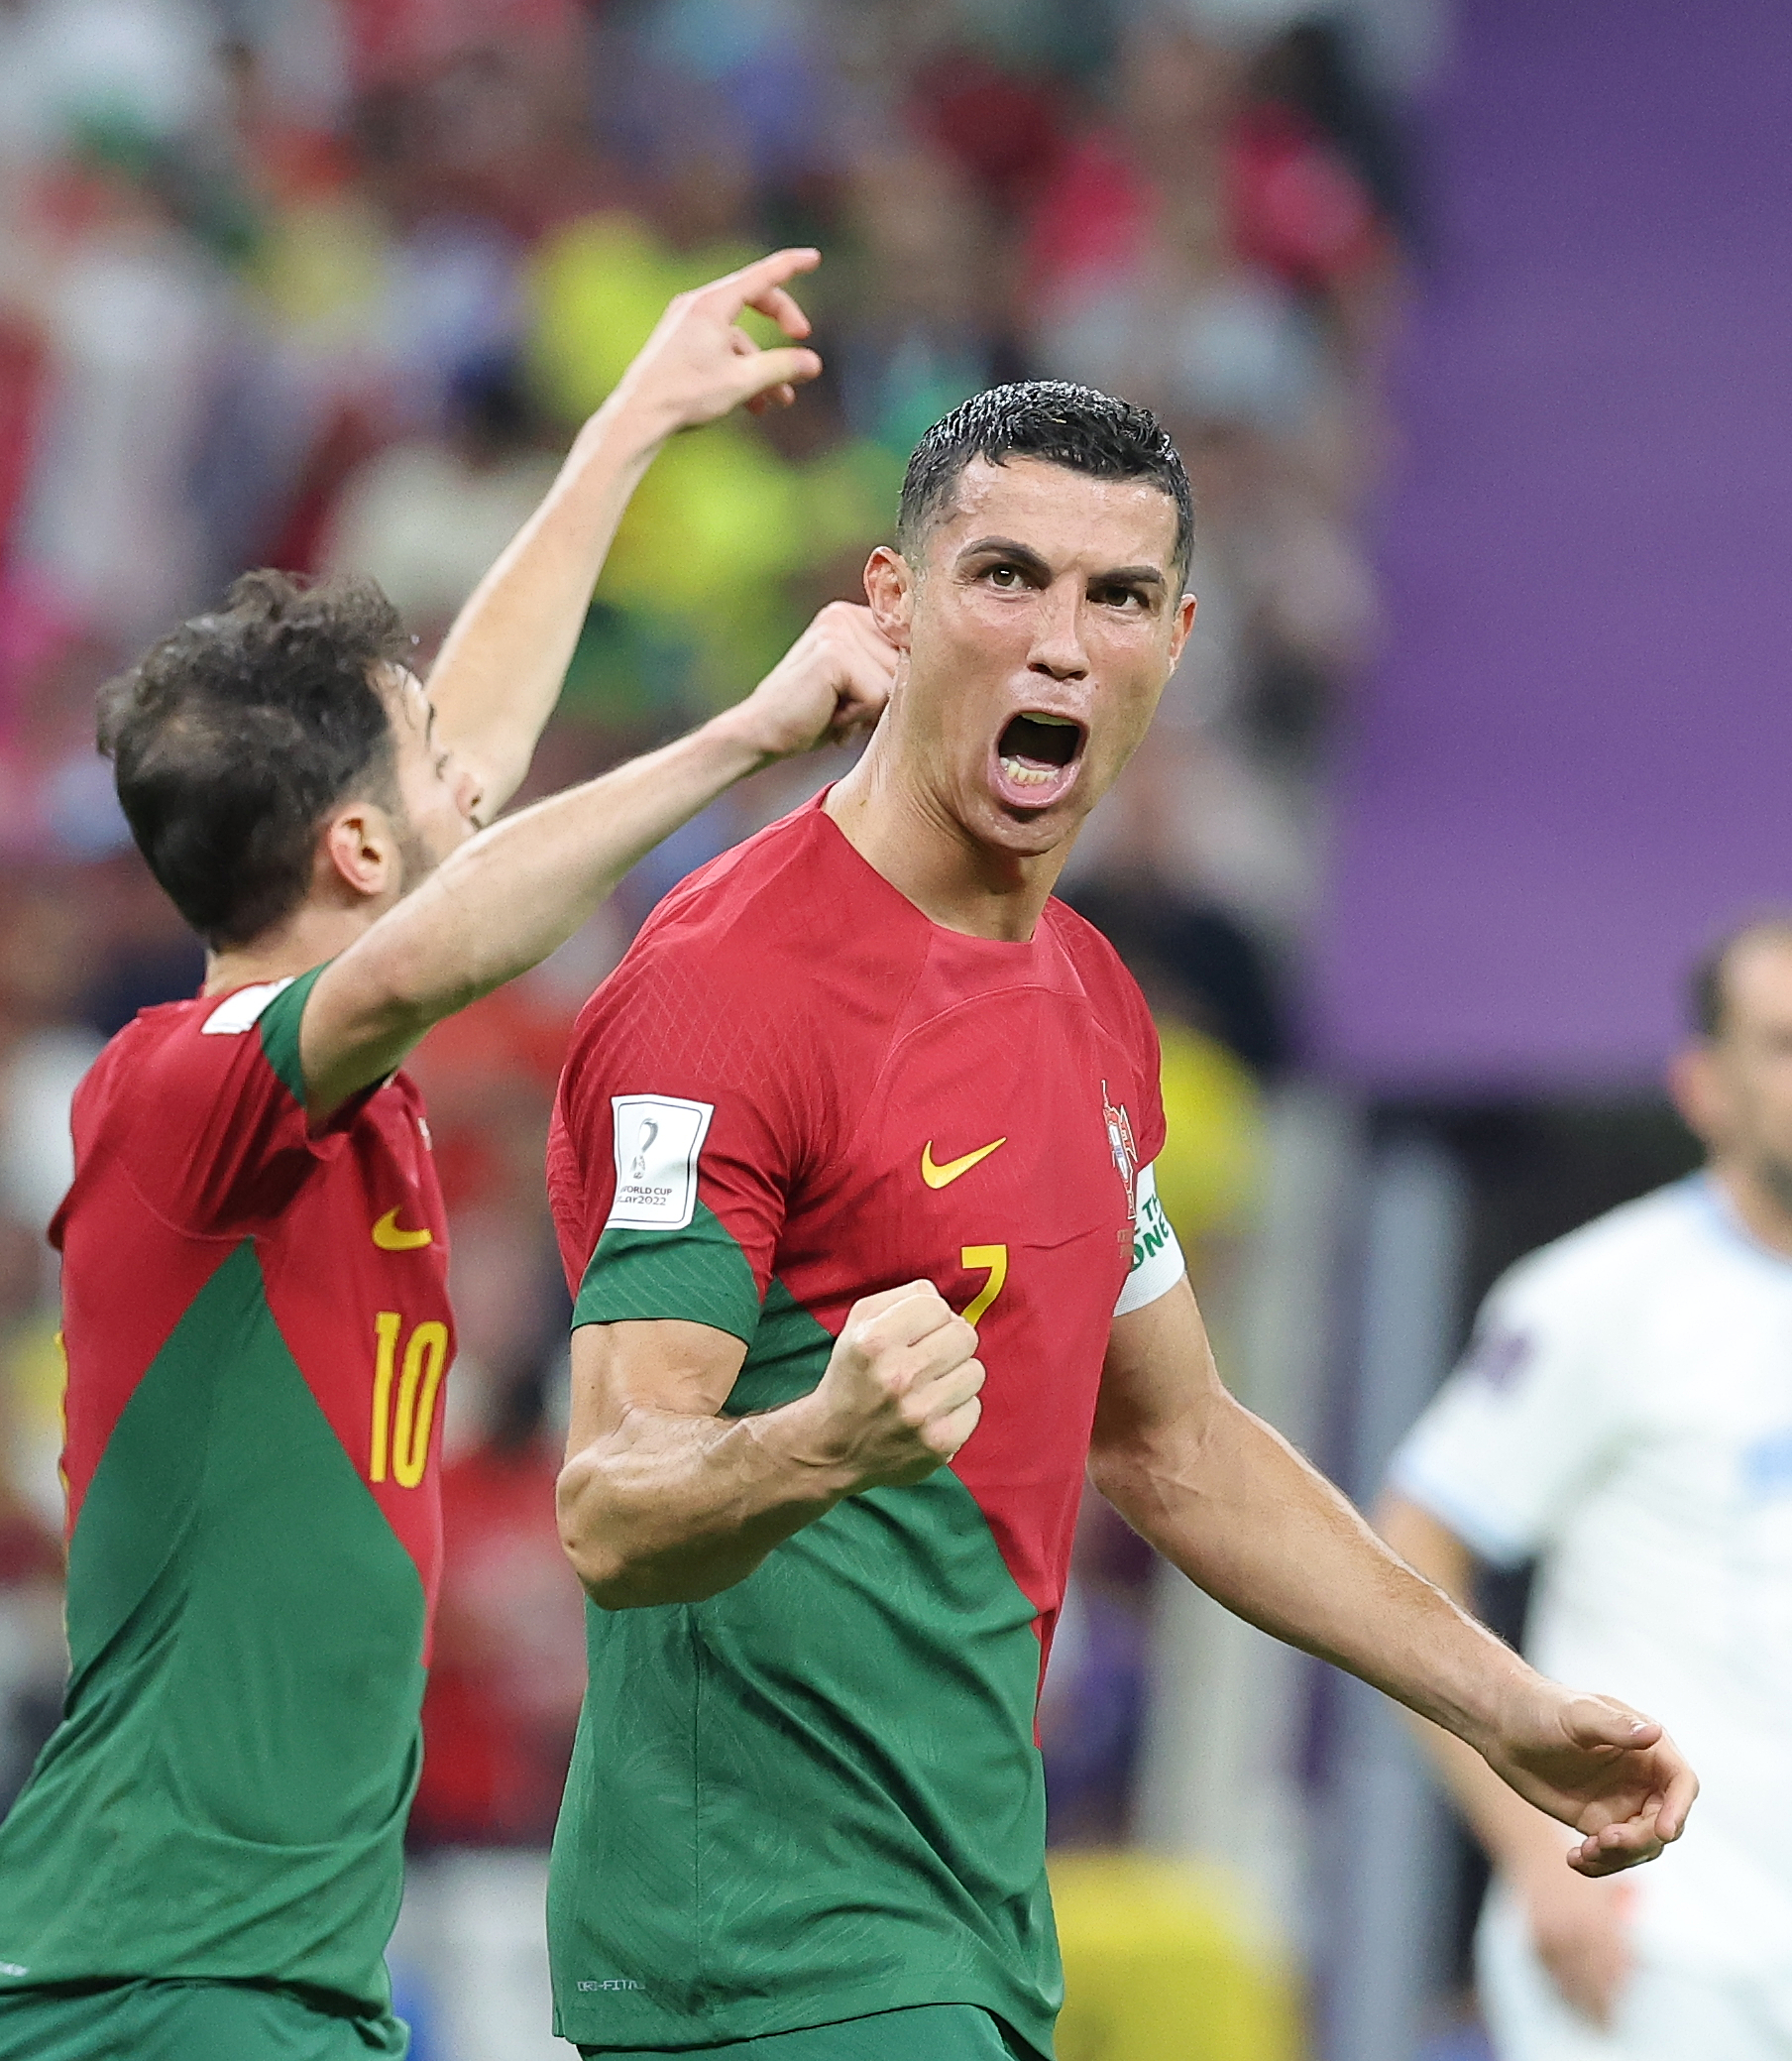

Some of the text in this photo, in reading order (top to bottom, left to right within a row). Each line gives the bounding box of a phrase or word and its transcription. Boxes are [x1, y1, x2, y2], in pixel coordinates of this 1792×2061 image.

[654, 1187, 673, 1196] CUP
[960, 1244, 1007, 1327] 7
[369, 1312, 448, 1488] 10
